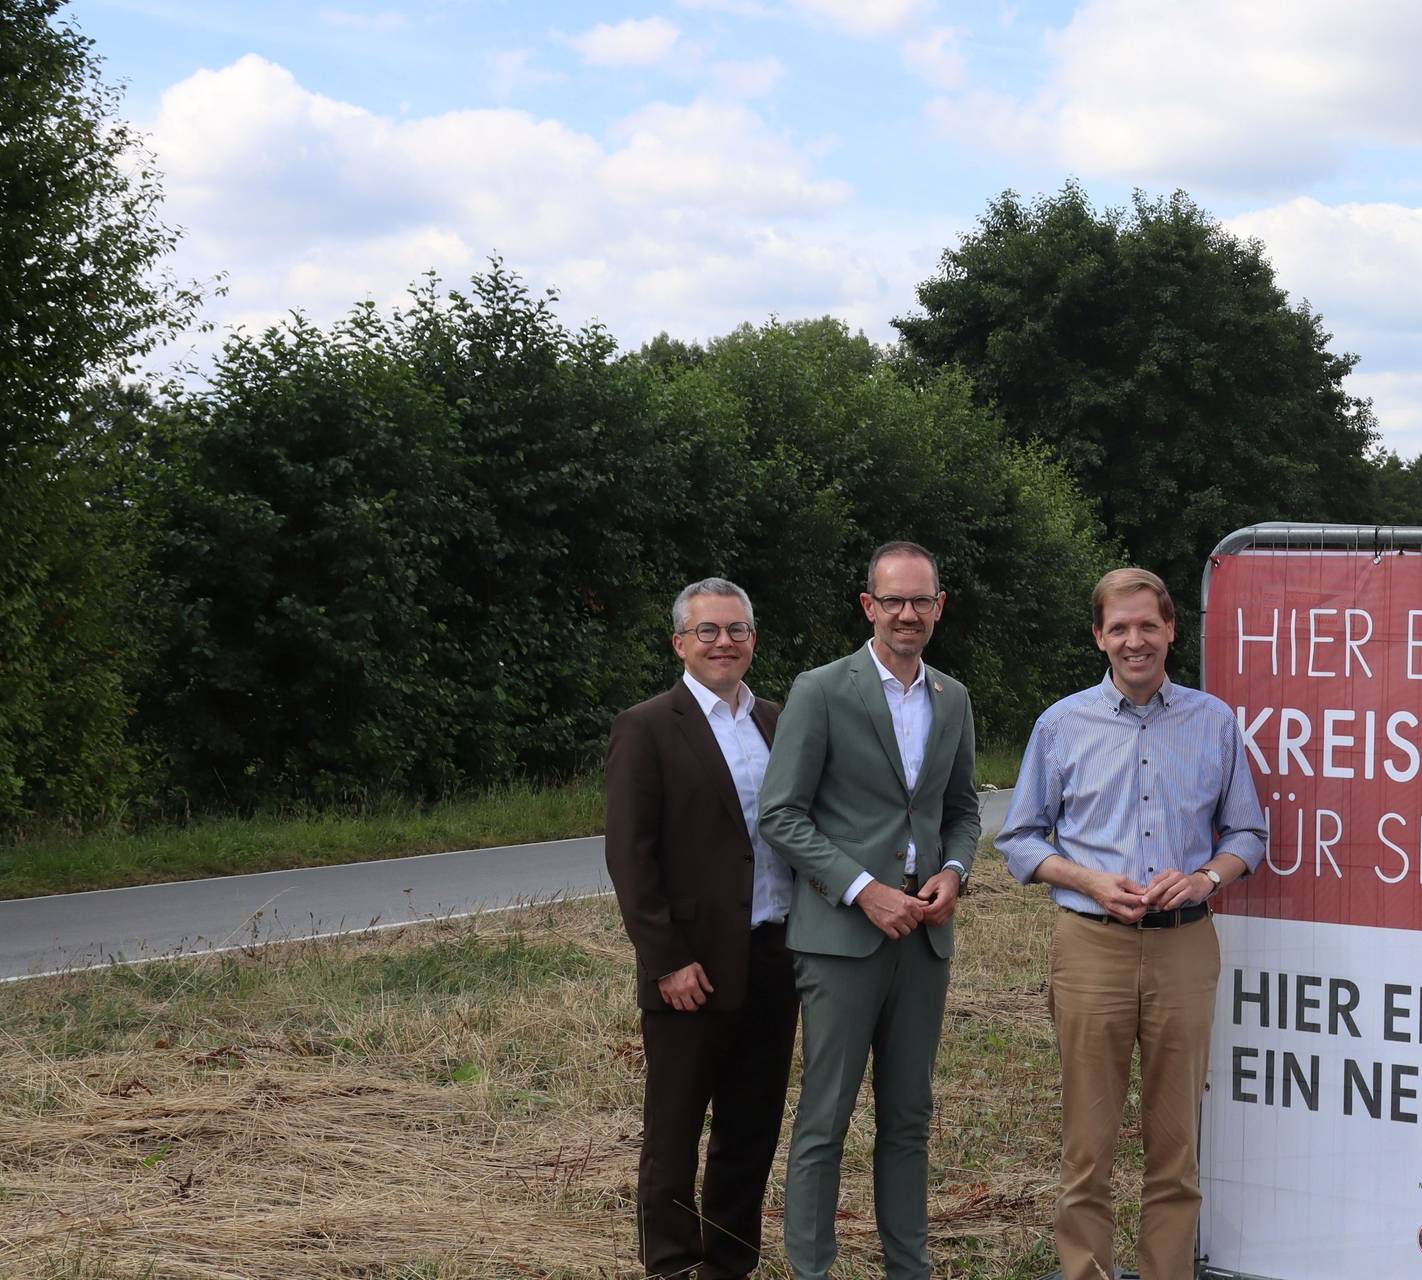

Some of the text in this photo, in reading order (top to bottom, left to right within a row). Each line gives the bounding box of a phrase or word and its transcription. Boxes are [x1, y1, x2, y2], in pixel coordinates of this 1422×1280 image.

[1237, 607, 1373, 679] HIER
[1236, 706, 1421, 783] KREIS
[1264, 791, 1343, 879] ÜR
[1232, 968, 1362, 1038] HIER
[1232, 1045, 1320, 1112] EIN
